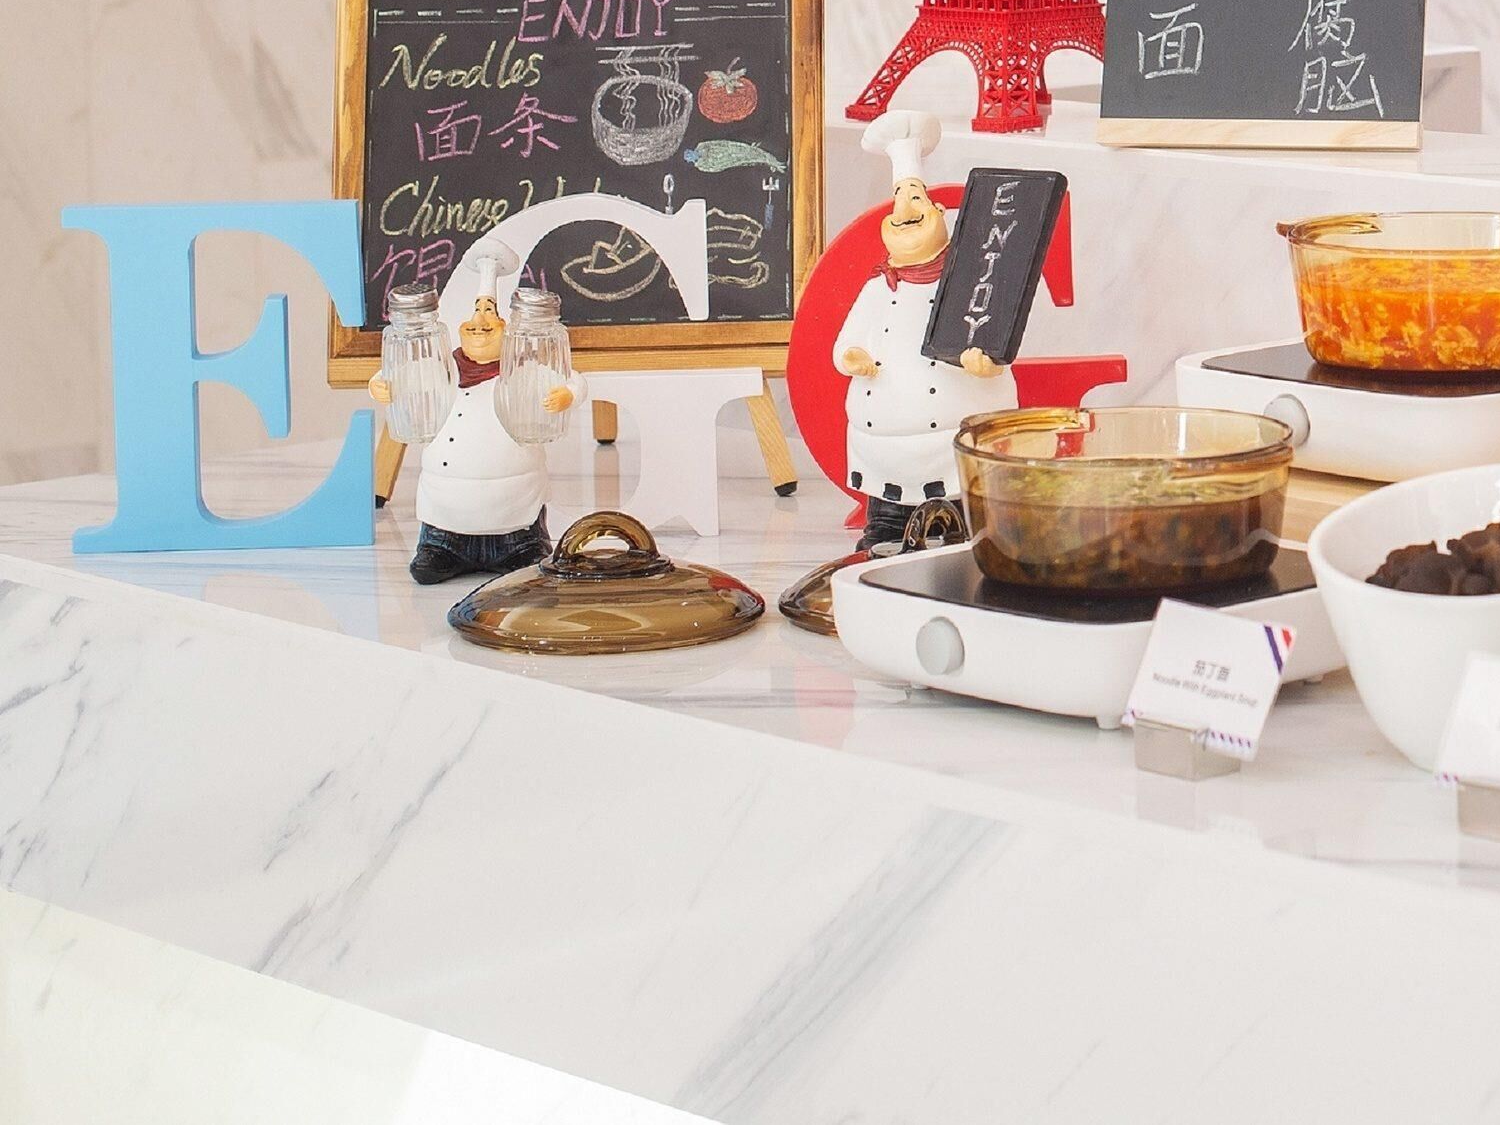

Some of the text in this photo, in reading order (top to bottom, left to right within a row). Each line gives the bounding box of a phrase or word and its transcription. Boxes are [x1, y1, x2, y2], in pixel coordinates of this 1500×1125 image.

[379, 32, 544, 91] Noodles
[414, 93, 579, 163] 面条
[379, 175, 510, 238] Chinese
[964, 180, 1021, 345] ENJOY
